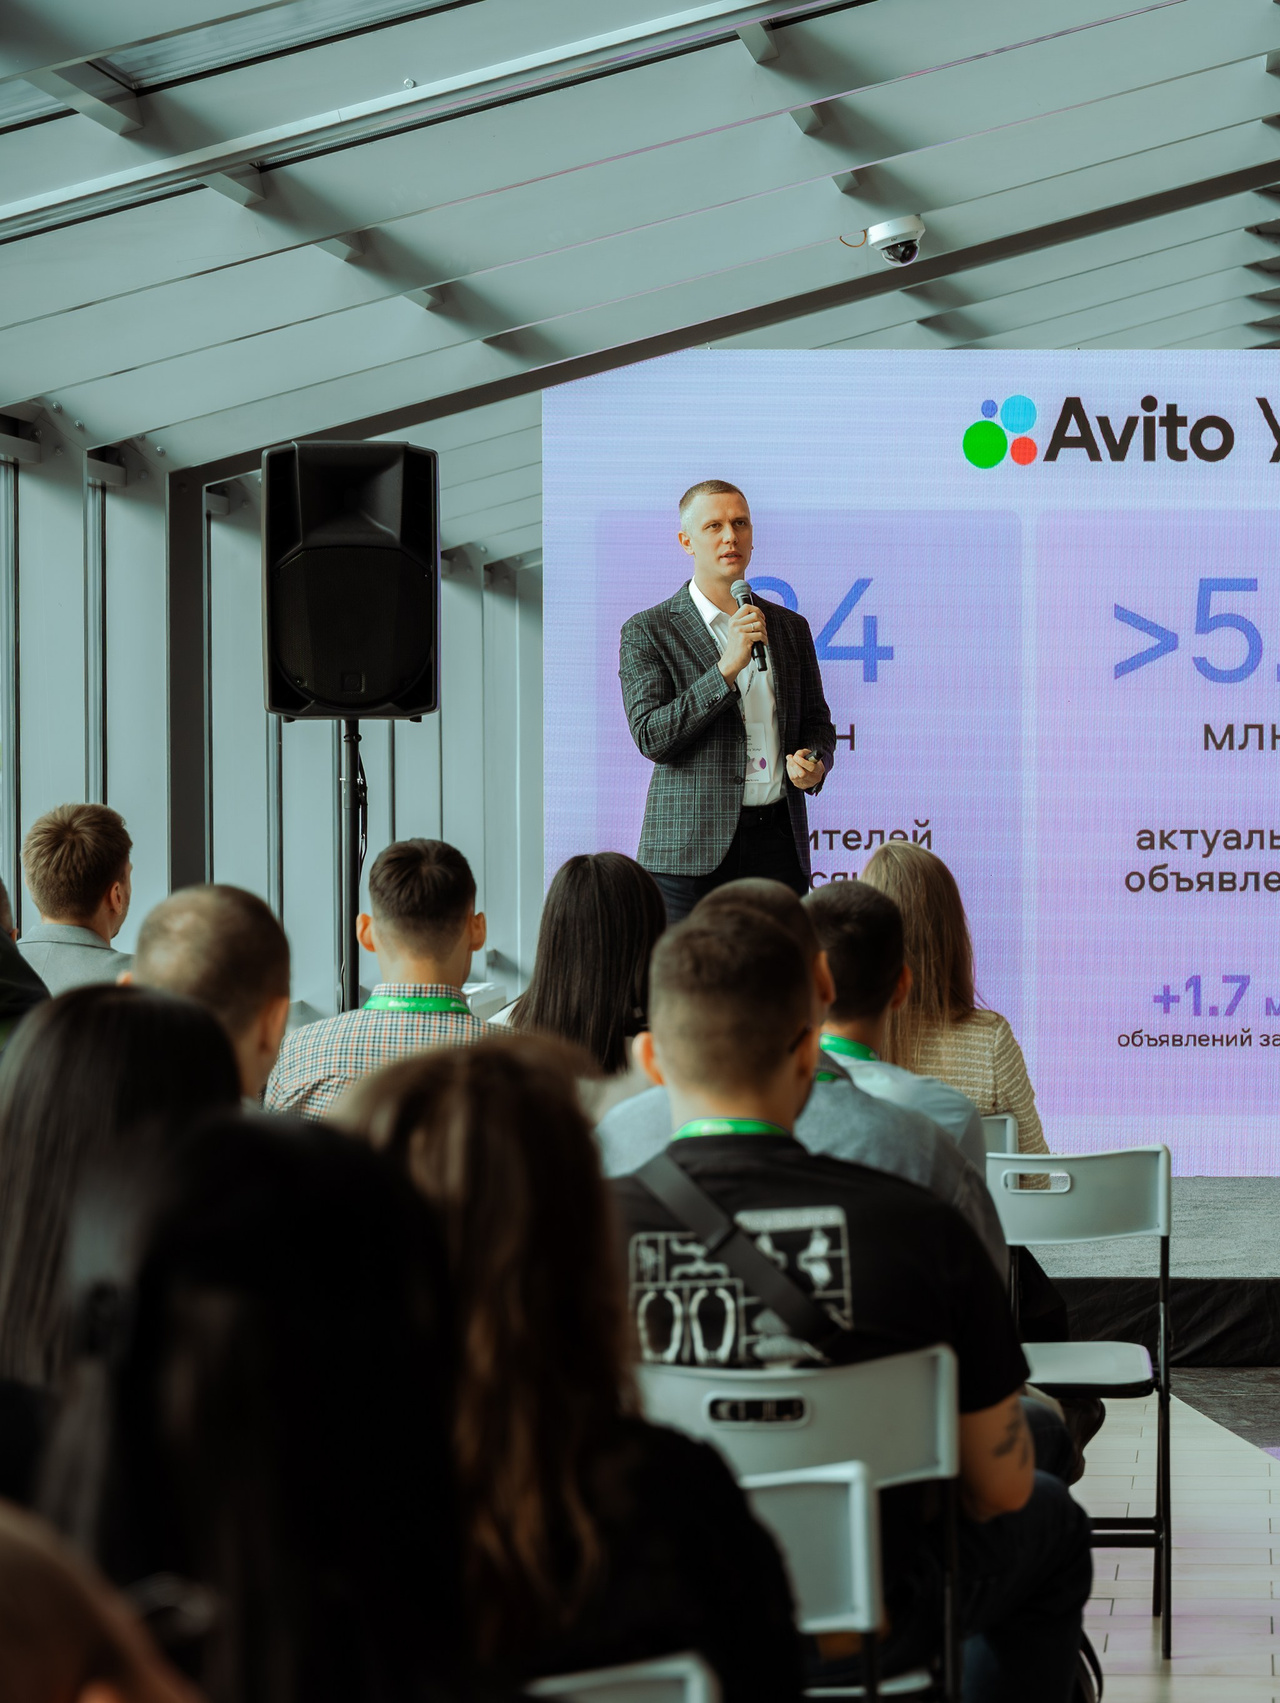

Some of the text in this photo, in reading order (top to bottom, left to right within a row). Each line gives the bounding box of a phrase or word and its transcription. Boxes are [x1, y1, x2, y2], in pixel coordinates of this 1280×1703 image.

[1043, 394, 1235, 463] Avito
[809, 818, 933, 852] ителей
[1152, 971, 1251, 1018] +1.7
[1117, 1027, 1253, 1048] объявлений
